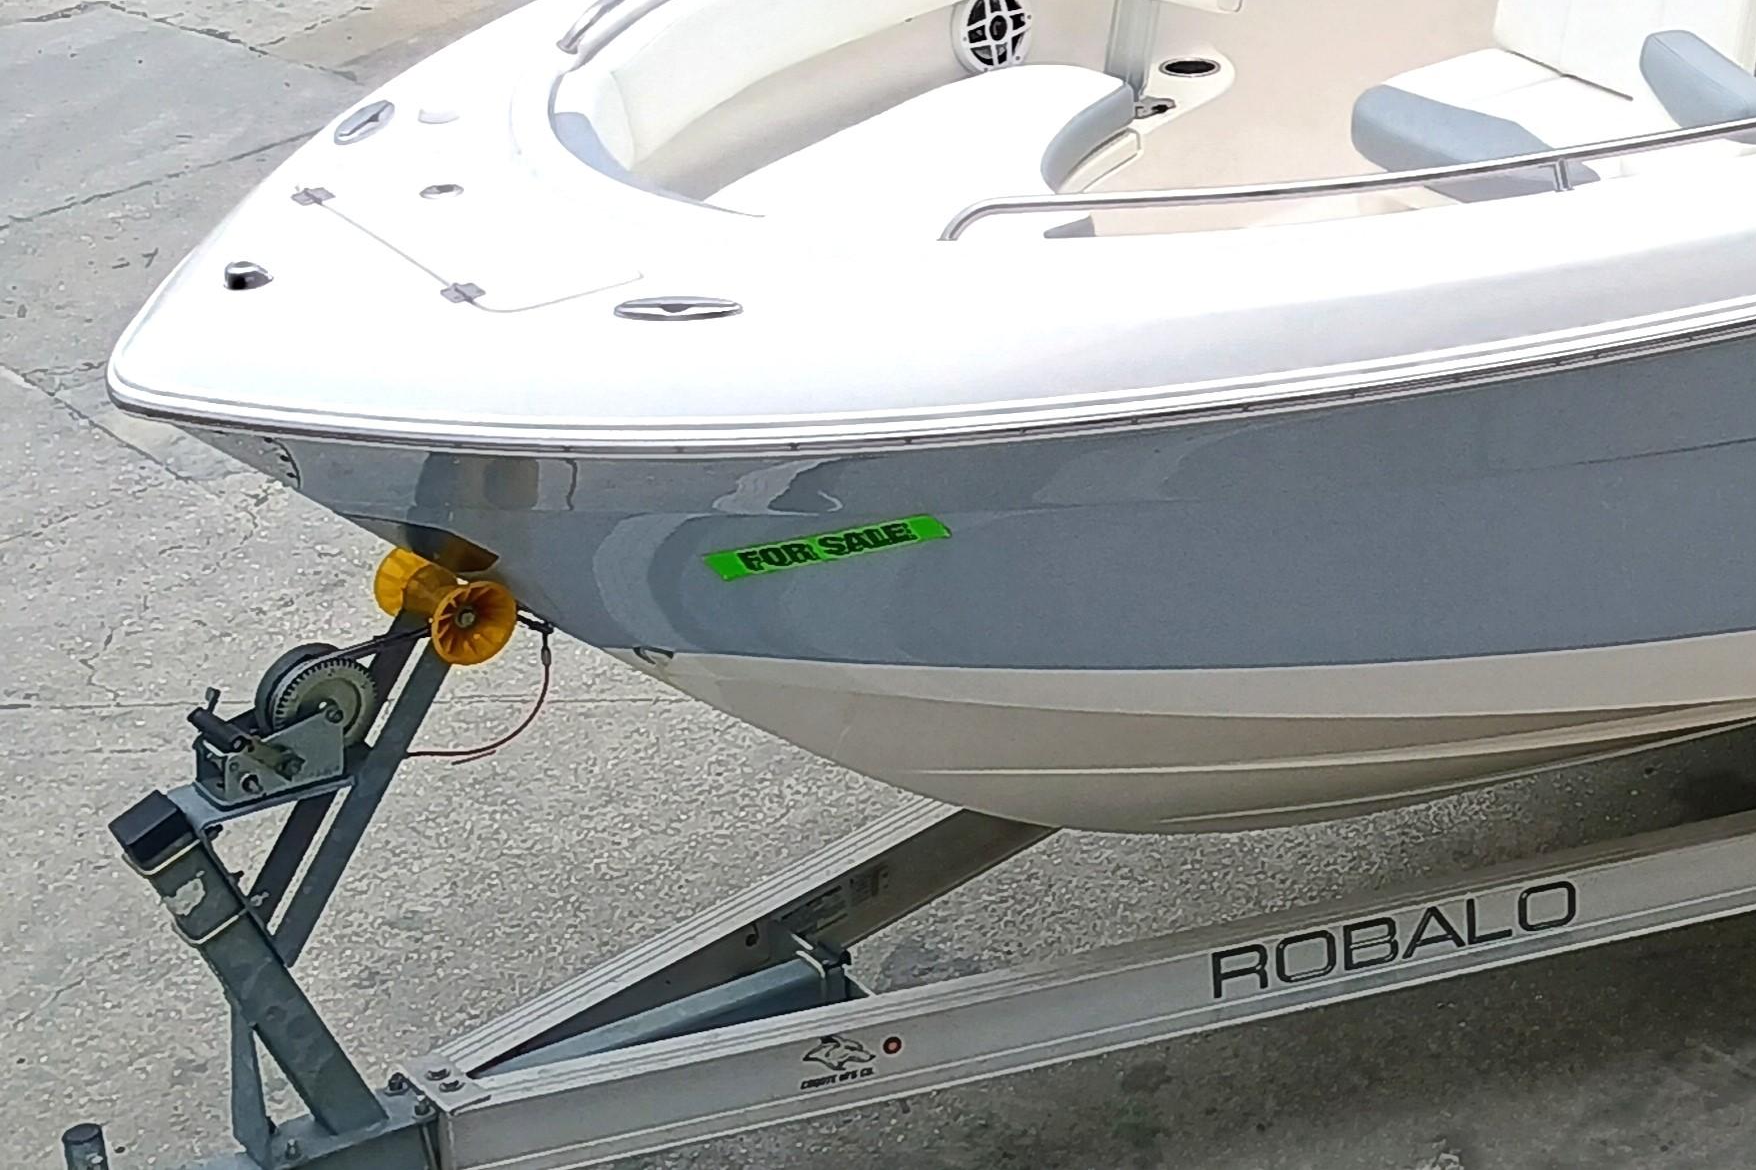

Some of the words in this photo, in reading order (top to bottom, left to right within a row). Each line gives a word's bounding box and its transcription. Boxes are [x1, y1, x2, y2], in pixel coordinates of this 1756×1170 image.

[737, 543, 820, 572] FOR
[817, 522, 918, 556] SALE
[1211, 880, 1577, 999] ROBALO
